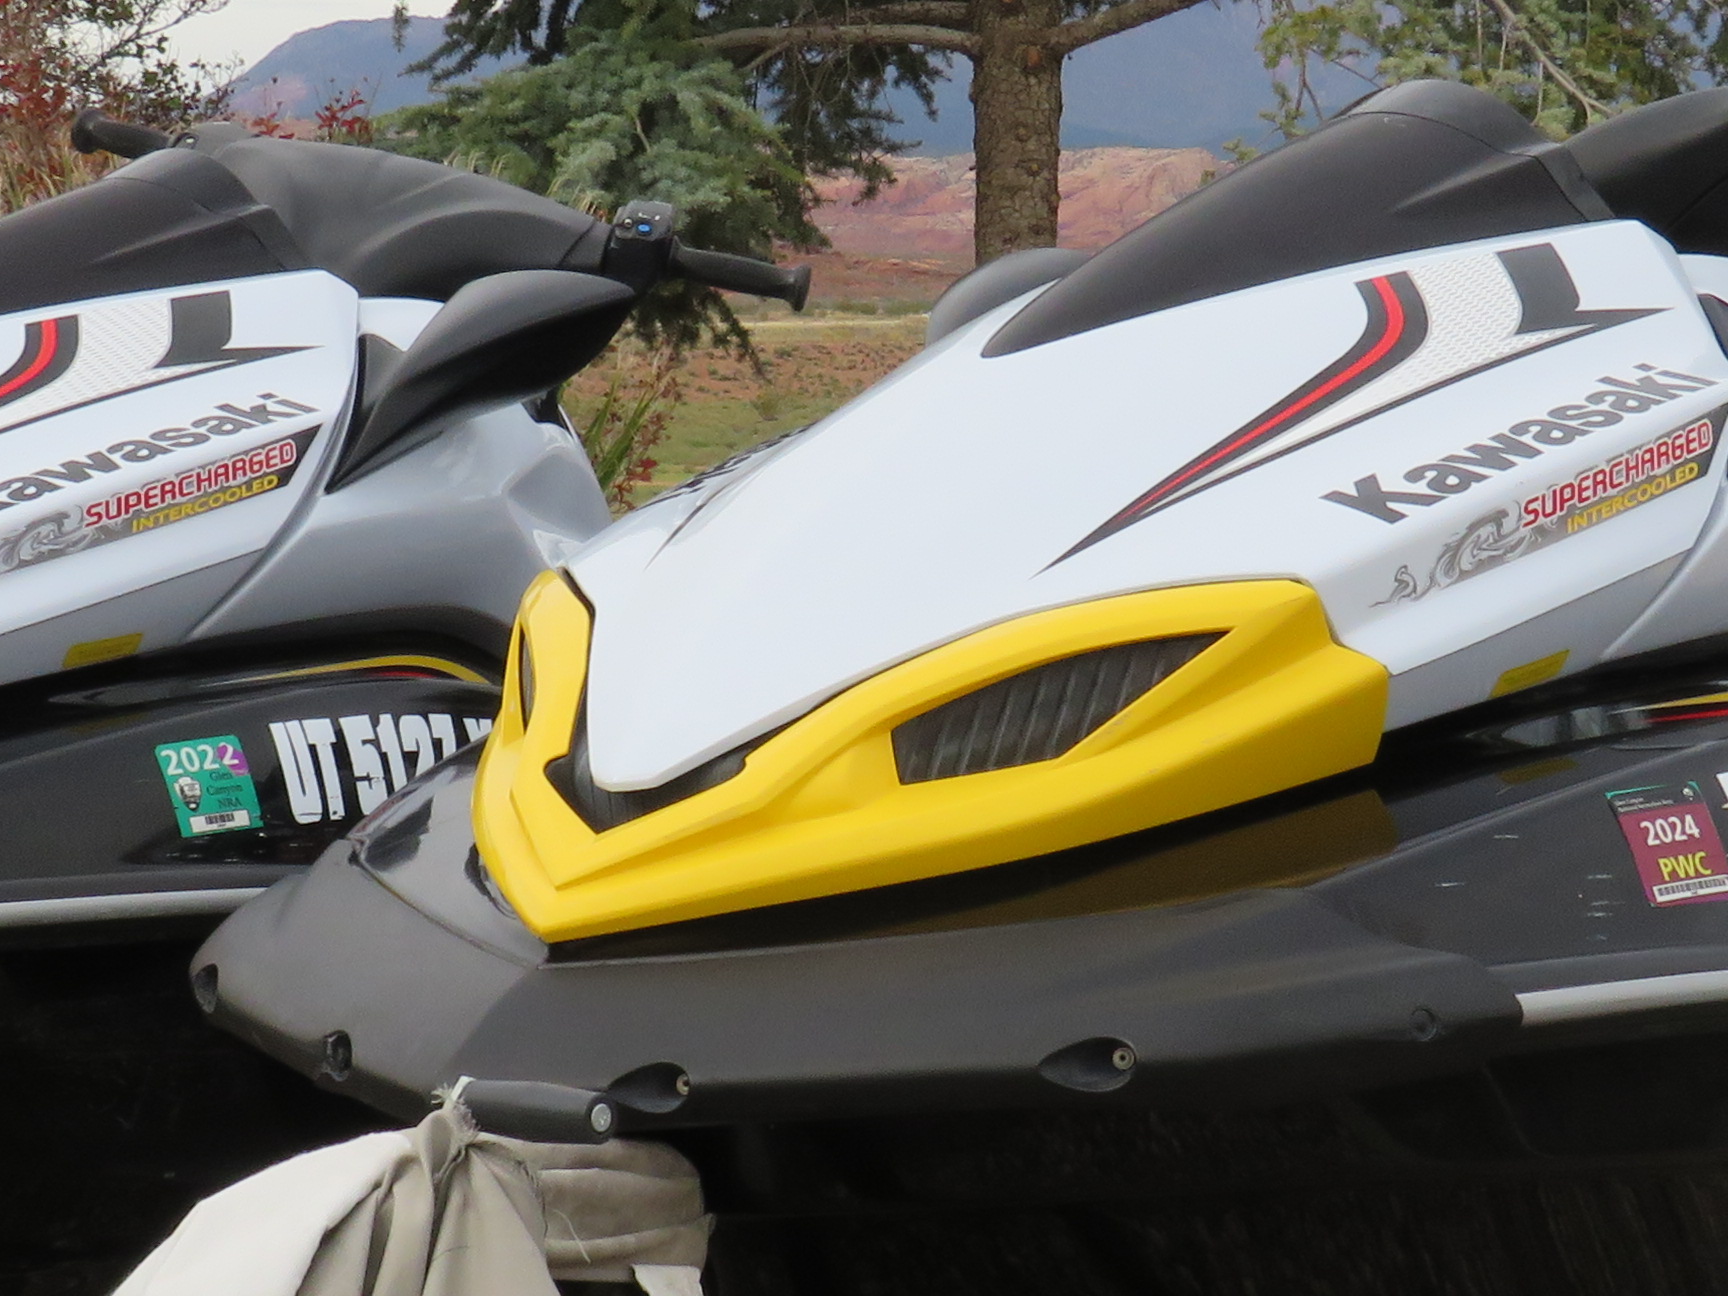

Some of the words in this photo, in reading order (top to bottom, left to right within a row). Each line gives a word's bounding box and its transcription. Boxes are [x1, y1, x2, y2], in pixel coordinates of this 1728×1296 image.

[1319, 363, 1721, 525] Kawasaki
[1521, 421, 1714, 530] SUPERCHARGED
[84, 440, 297, 529] SUPERCHARGED
[131, 474, 280, 533] INTERCOOLED
[1566, 461, 1700, 534] INTERCOOLED
[160, 741, 240, 776] 2022
[1639, 813, 1701, 846] 2024
[1657, 851, 1713, 882] PWC
